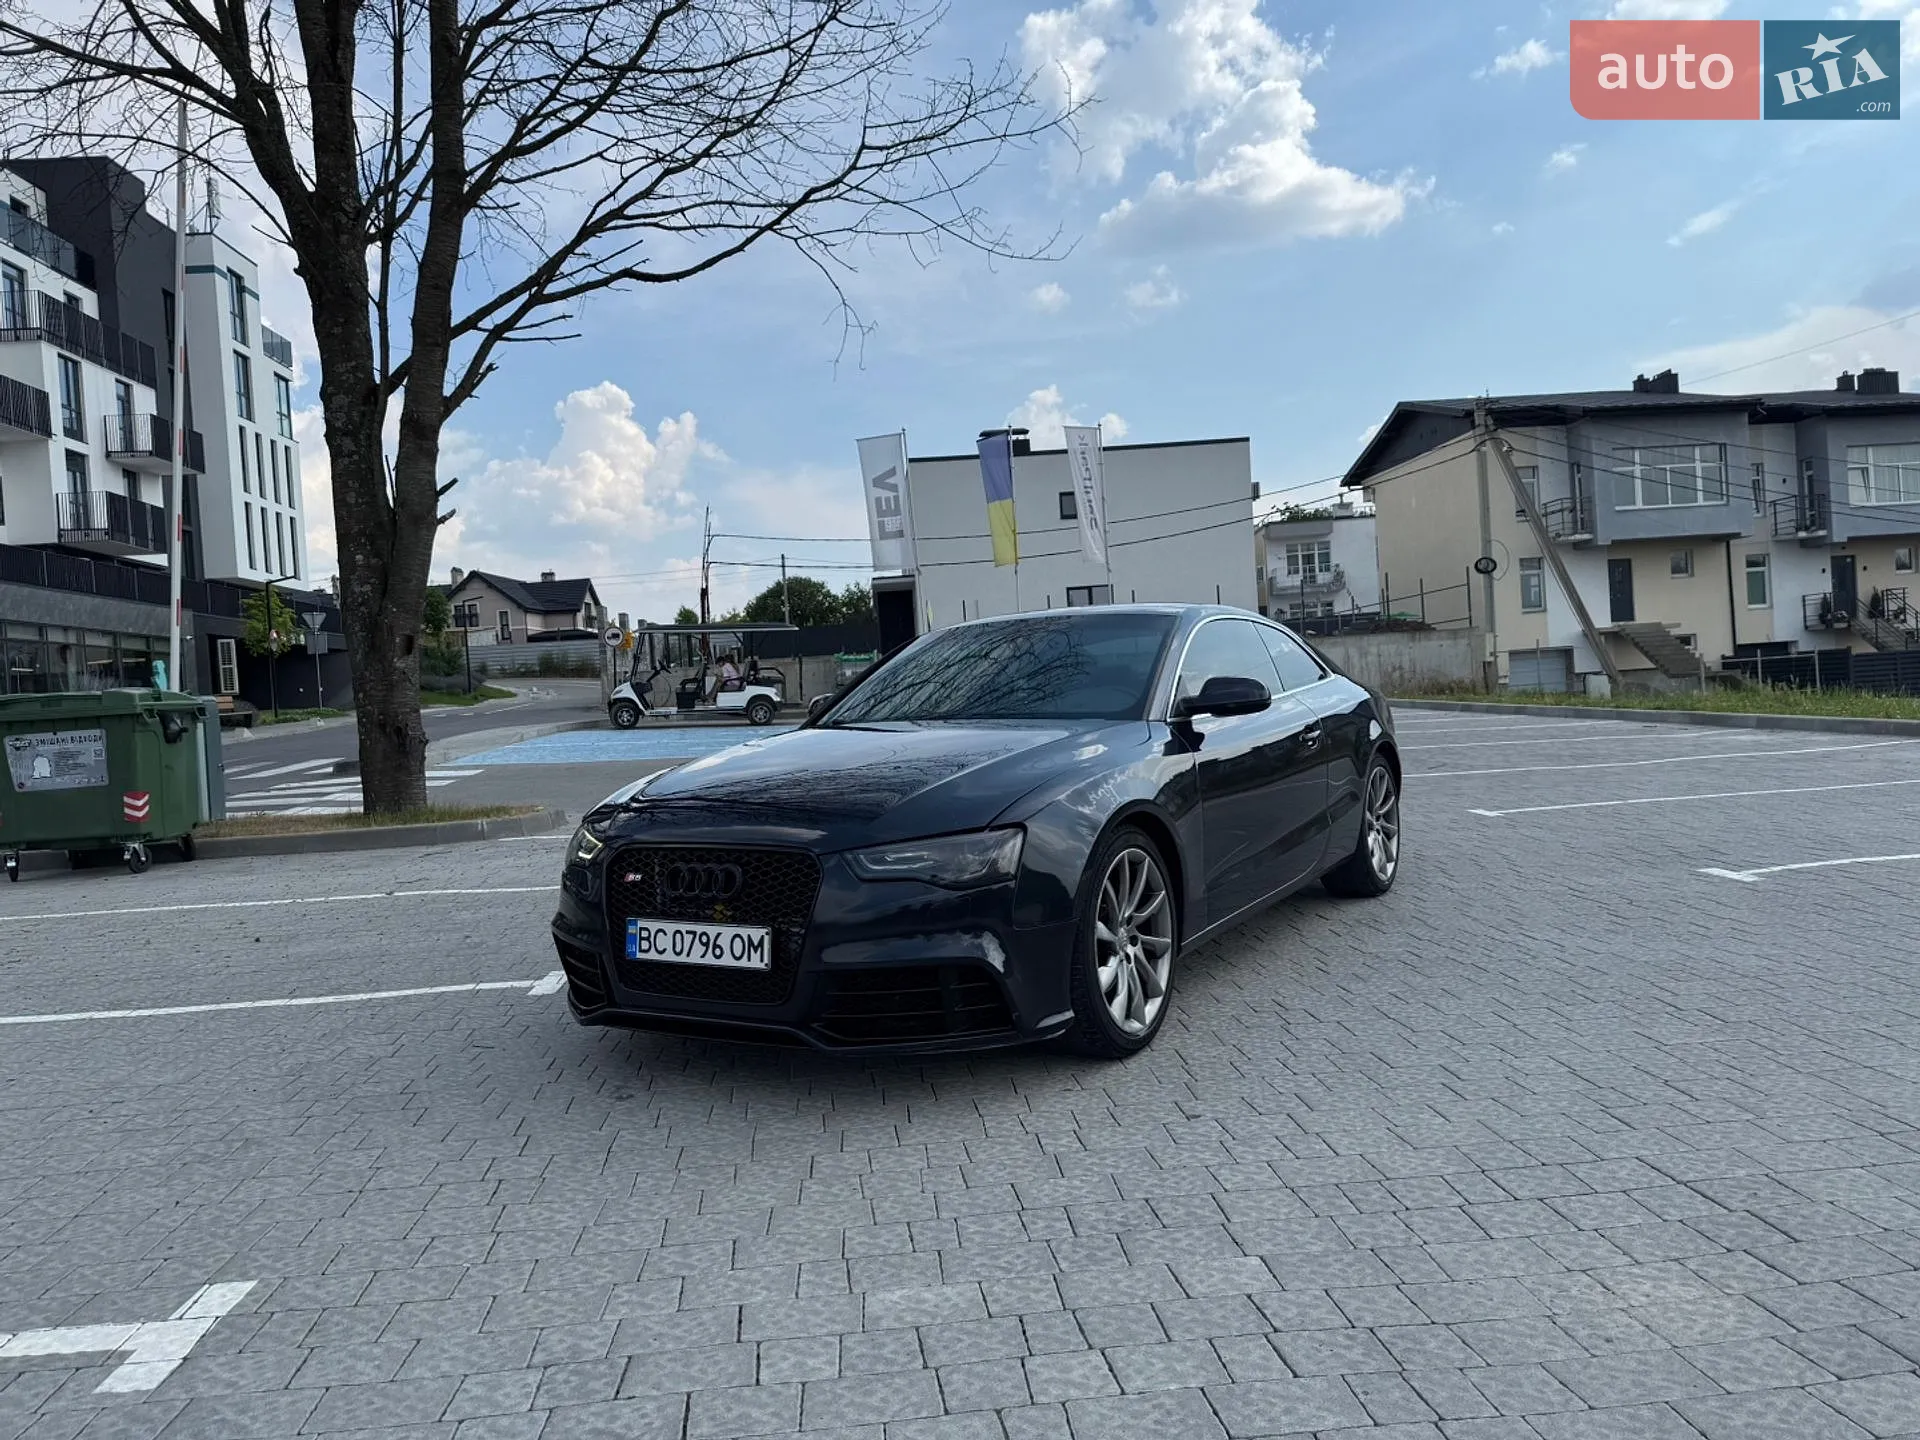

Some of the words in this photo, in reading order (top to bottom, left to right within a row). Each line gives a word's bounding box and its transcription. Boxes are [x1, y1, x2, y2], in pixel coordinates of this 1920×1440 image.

[638, 926, 668, 955] BC
[672, 929, 725, 959] 0796
[730, 933, 765, 963] OM
